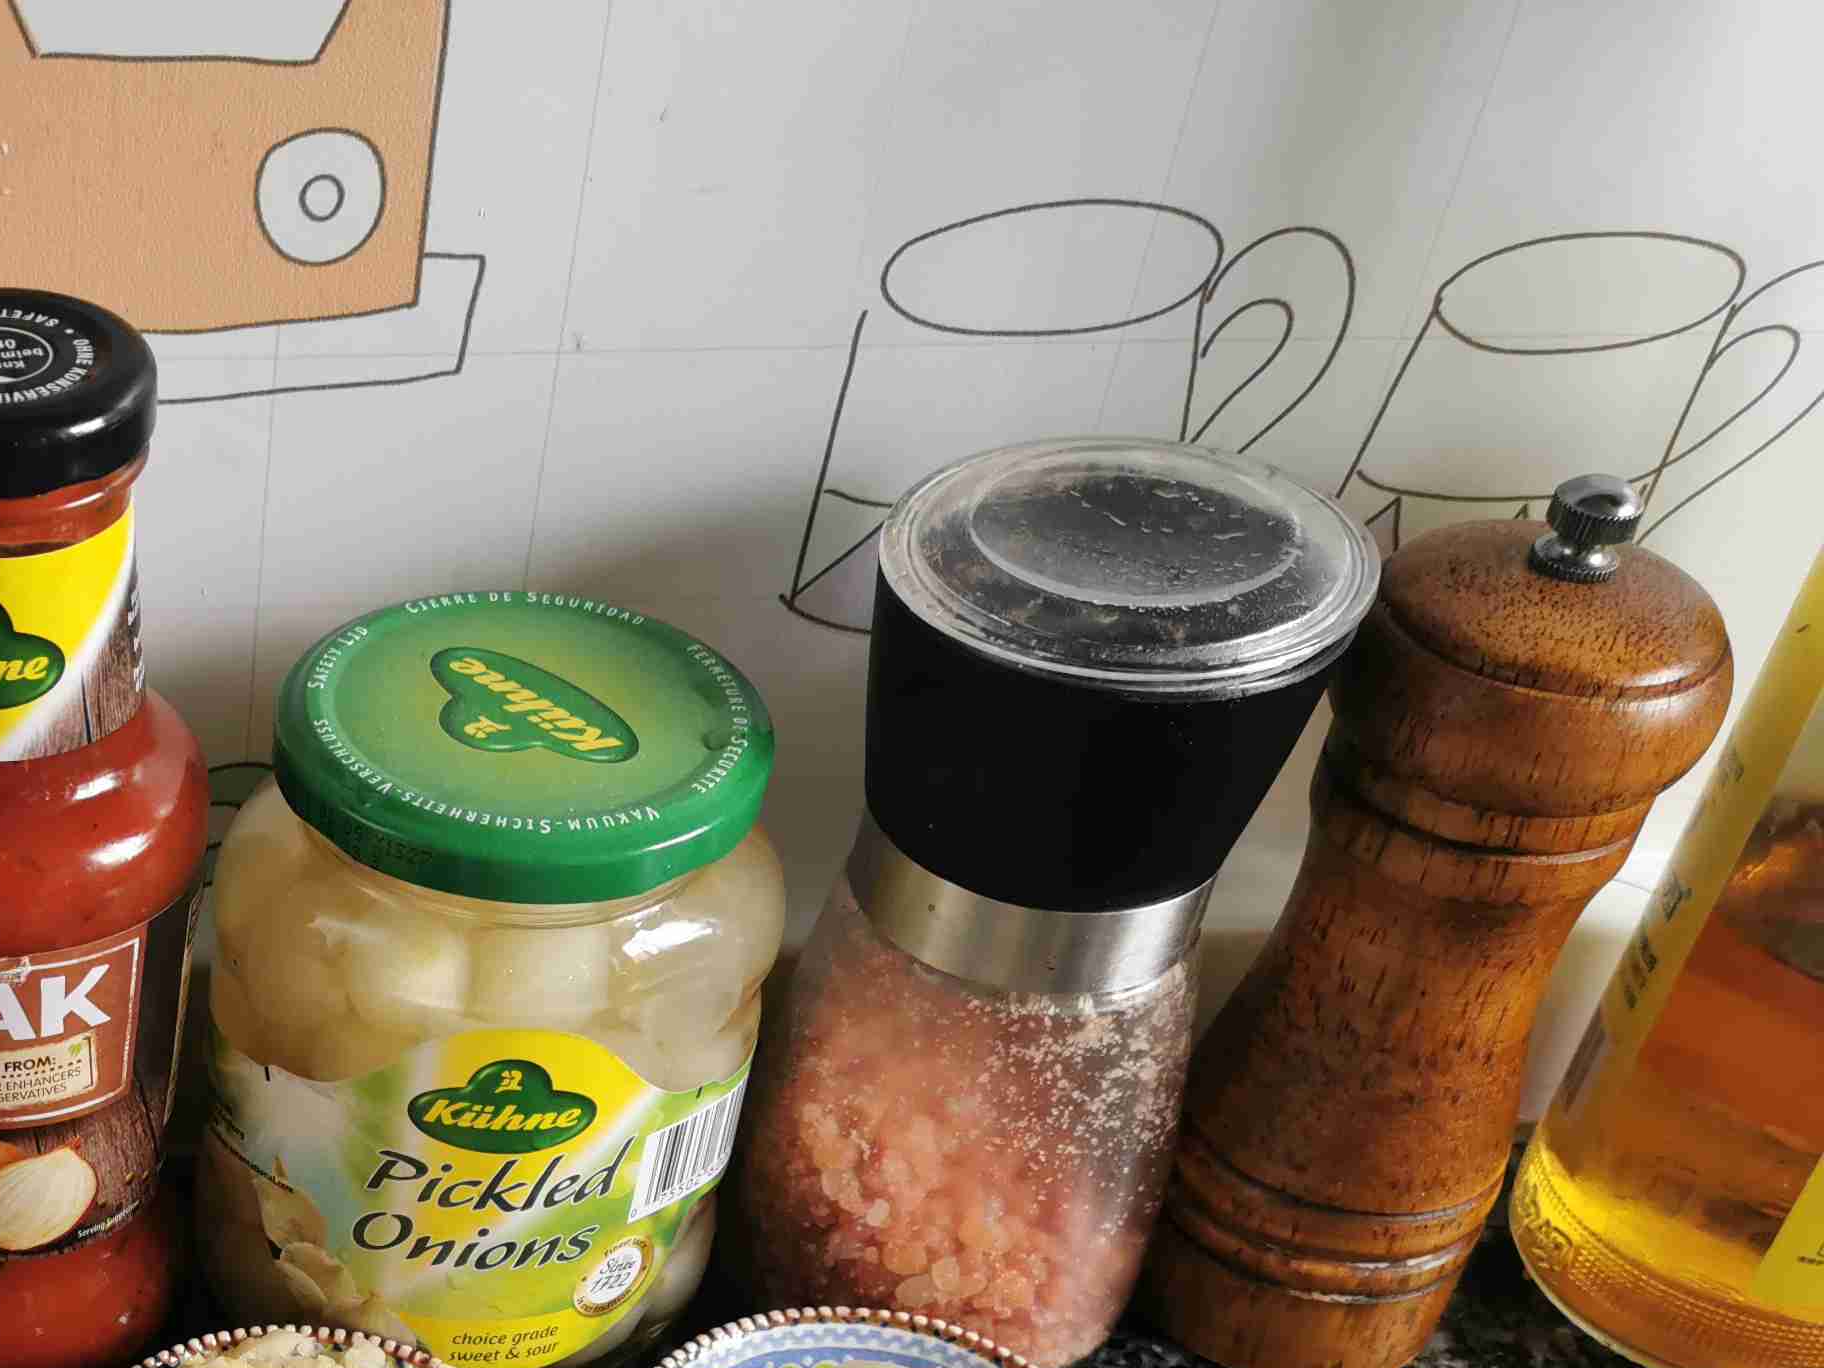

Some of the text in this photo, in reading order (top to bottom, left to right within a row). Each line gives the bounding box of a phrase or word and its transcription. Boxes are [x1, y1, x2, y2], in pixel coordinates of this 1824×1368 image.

[488, 591, 513, 603] DE
[527, 591, 645, 626] SEGURIDAD
[306, 647, 343, 690] SAFETY
[448, 657, 625, 753] Kühne
[4, 1055, 57, 1073] FROM:
[5, 1067, 82, 1091] ENHANCERS
[422, 1097, 584, 1135] Kühne
[366, 1135, 635, 1213] Pickled
[352, 1212, 600, 1272] Onions
[449, 1341, 560, 1362] sweet & sour
[452, 1324, 560, 1346] choice grade
